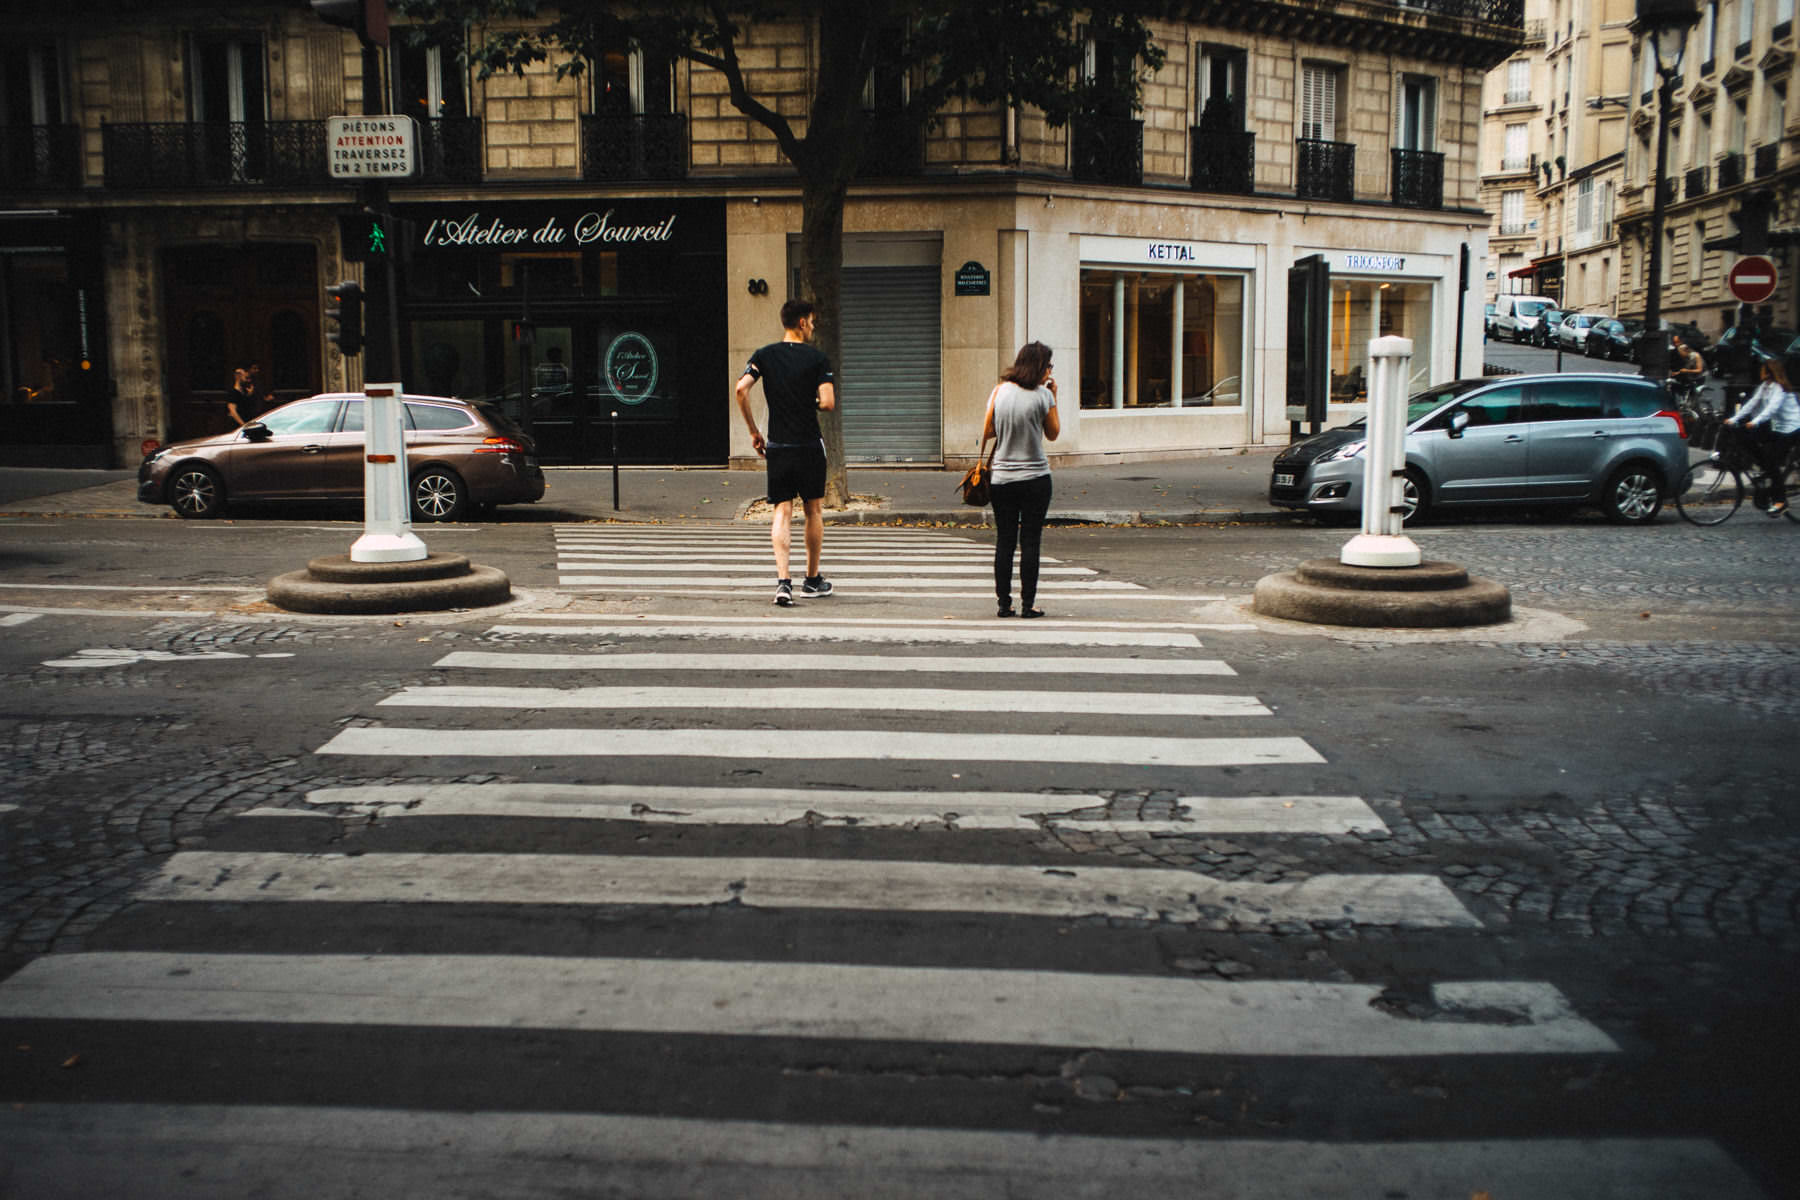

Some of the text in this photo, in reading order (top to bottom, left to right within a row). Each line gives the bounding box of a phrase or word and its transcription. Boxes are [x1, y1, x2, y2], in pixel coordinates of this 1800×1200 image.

[336, 135, 404, 146] ATTENTION
[334, 149, 406, 160] TRAVERSEZ
[334, 162, 407, 173] EN 2 TEMPS
[533, 217, 566, 243] du
[574, 208, 676, 247] Sourcil
[1149, 244, 1196, 261] KETTAL
